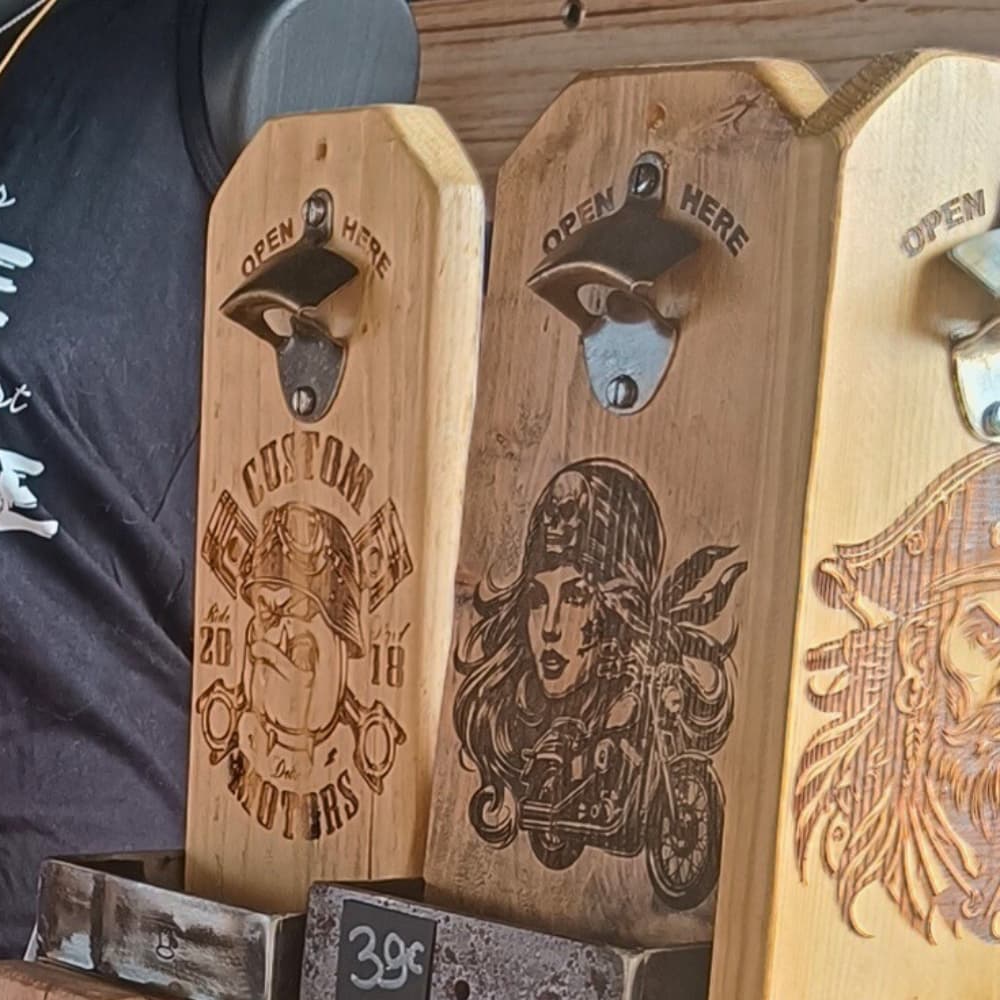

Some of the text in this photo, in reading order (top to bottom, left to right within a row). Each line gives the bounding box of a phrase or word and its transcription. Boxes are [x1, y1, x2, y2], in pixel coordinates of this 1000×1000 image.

[241, 215, 392, 280] OPEN HERE
[543, 183, 750, 257] OPEN HERE
[900, 188, 987, 258] OPEN
[242, 431, 375, 516] CUSTOM
[200, 626, 405, 688] 20 18
[228, 750, 359, 841] MOTORS
